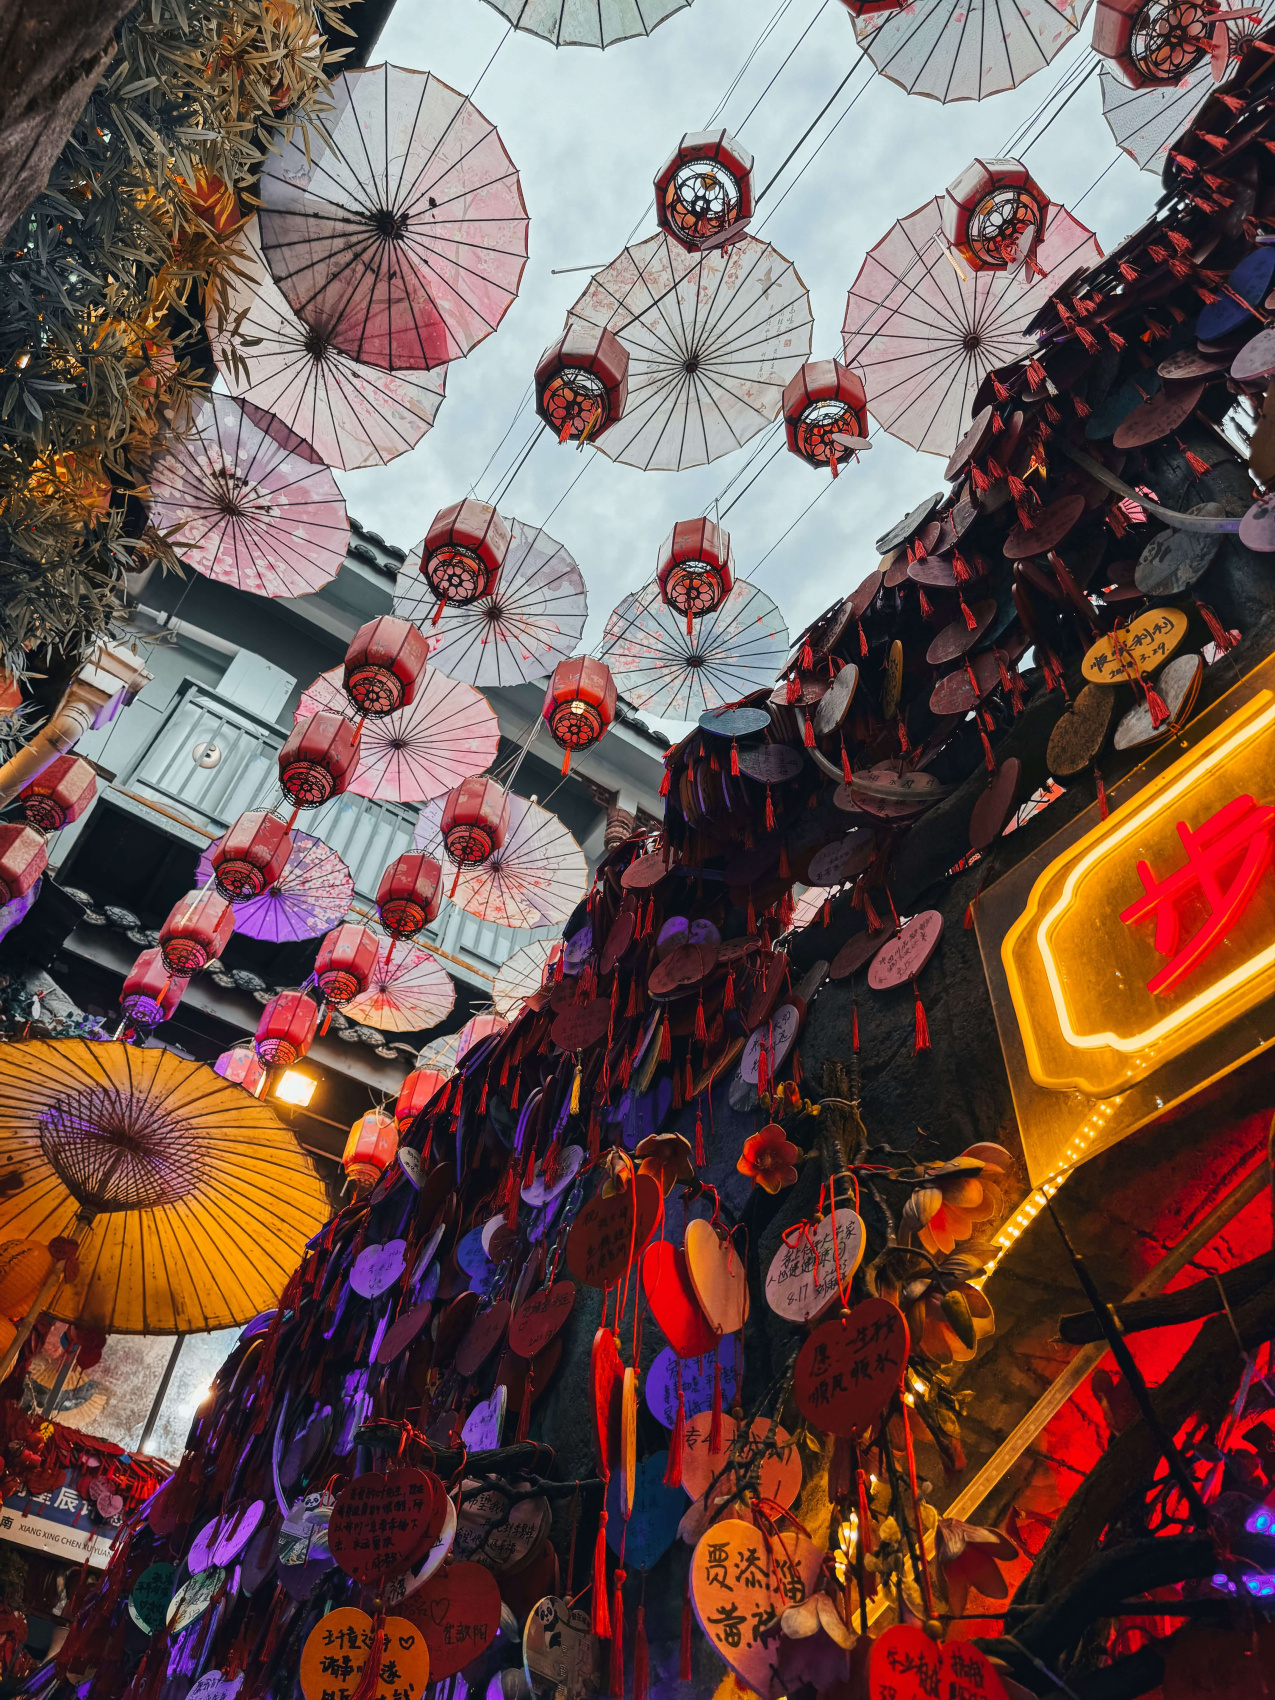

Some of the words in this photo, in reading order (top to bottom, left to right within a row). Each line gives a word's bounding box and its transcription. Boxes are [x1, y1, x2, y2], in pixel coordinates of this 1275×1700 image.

[1090, 616, 1175, 674] 顺顺利利
[0, 1515, 14, 1530] 南
[18, 1523, 41, 1537] XIANG
[42, 1529, 60, 1542] XING
[61, 1536, 82, 1549] CHEN
[319, 1653, 403, 1686] 诸事遂
